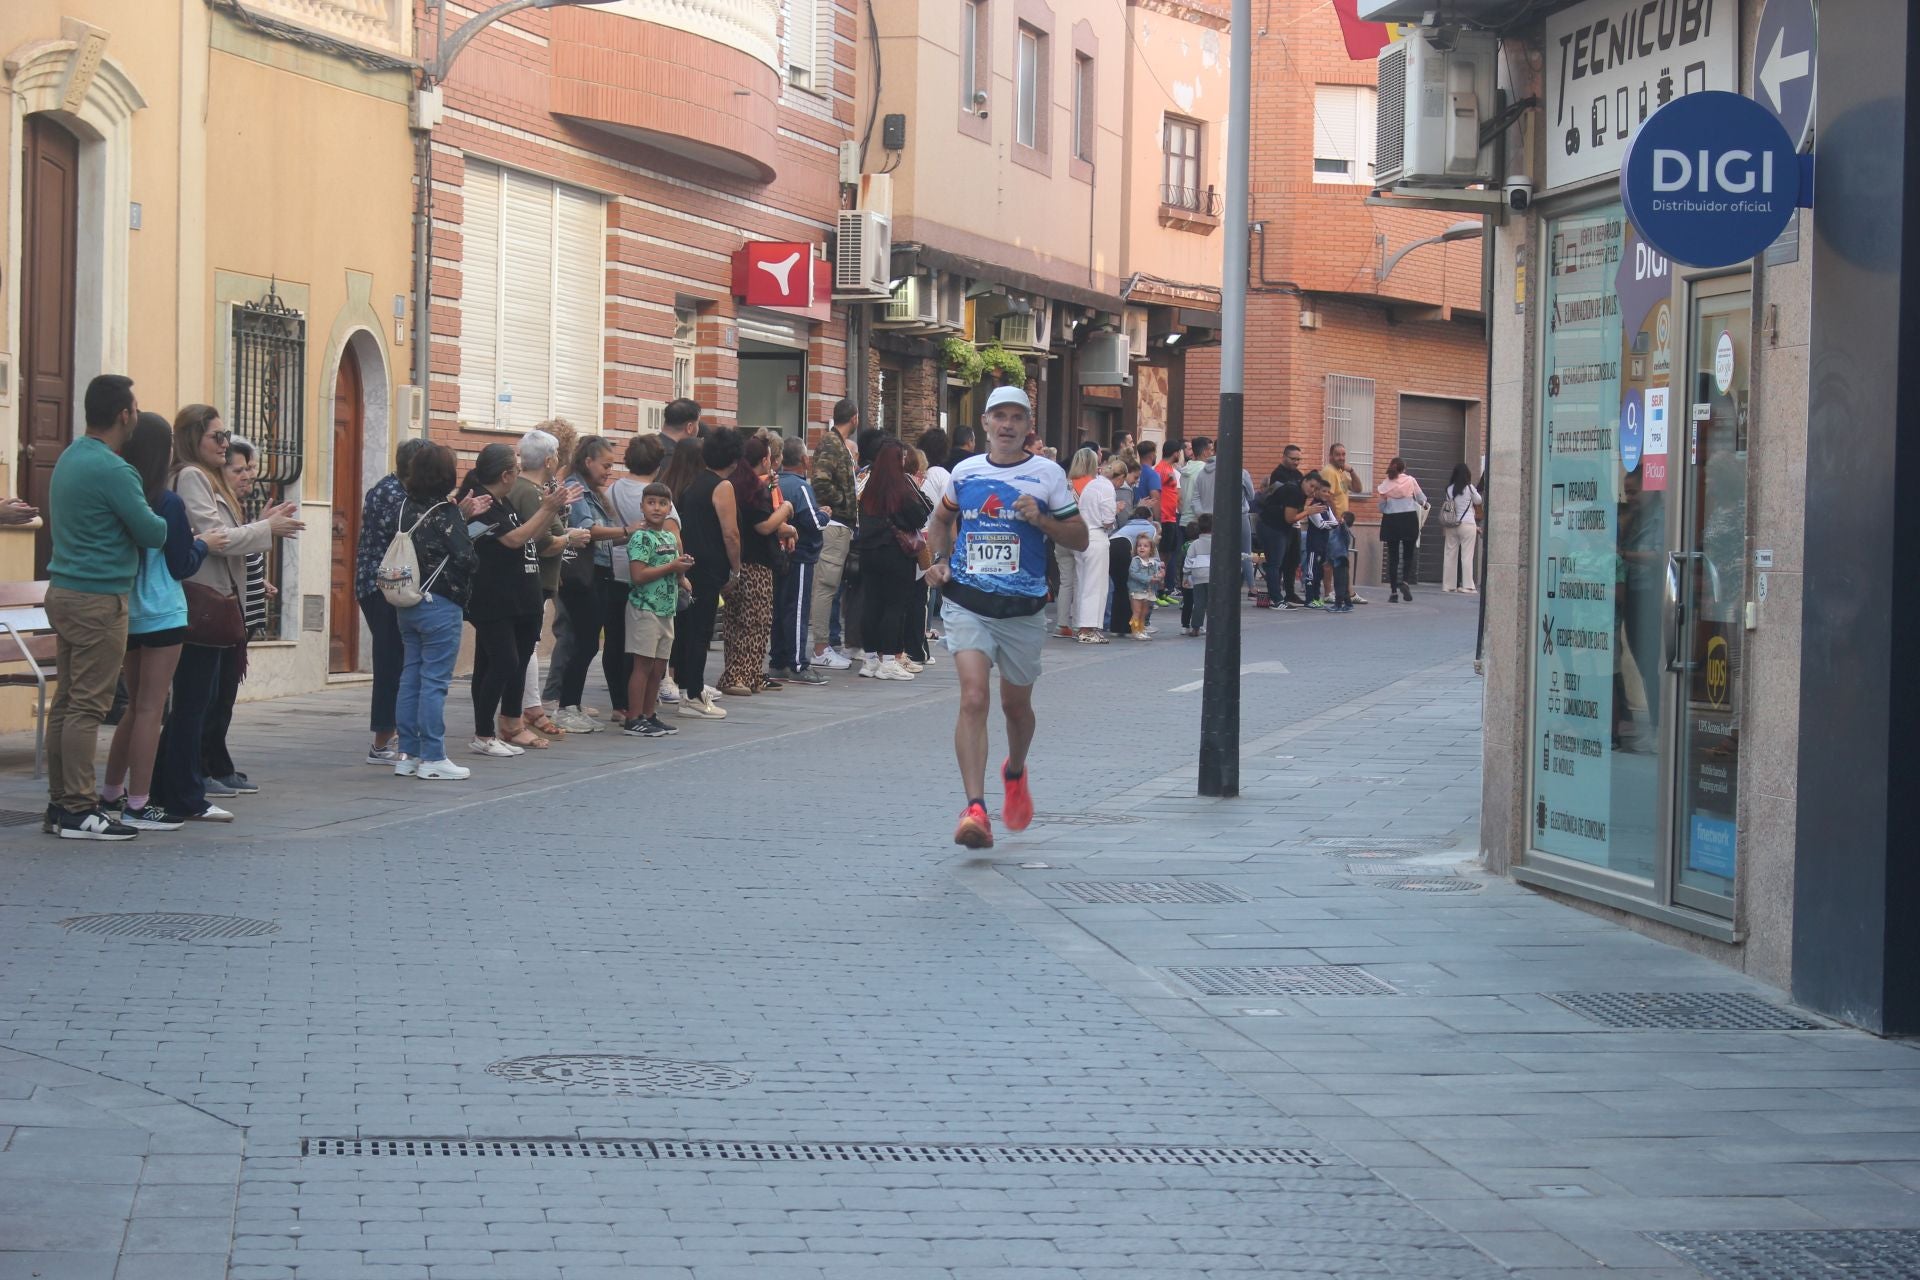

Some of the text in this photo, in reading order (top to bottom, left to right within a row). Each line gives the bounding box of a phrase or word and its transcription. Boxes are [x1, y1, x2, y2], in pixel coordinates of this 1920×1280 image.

[1653, 149, 1773, 194] DIGI
[1652, 199, 1772, 212] Distribuidor oficial
[977, 544, 1012, 560] 1073
[1708, 659, 1725, 697] ups
